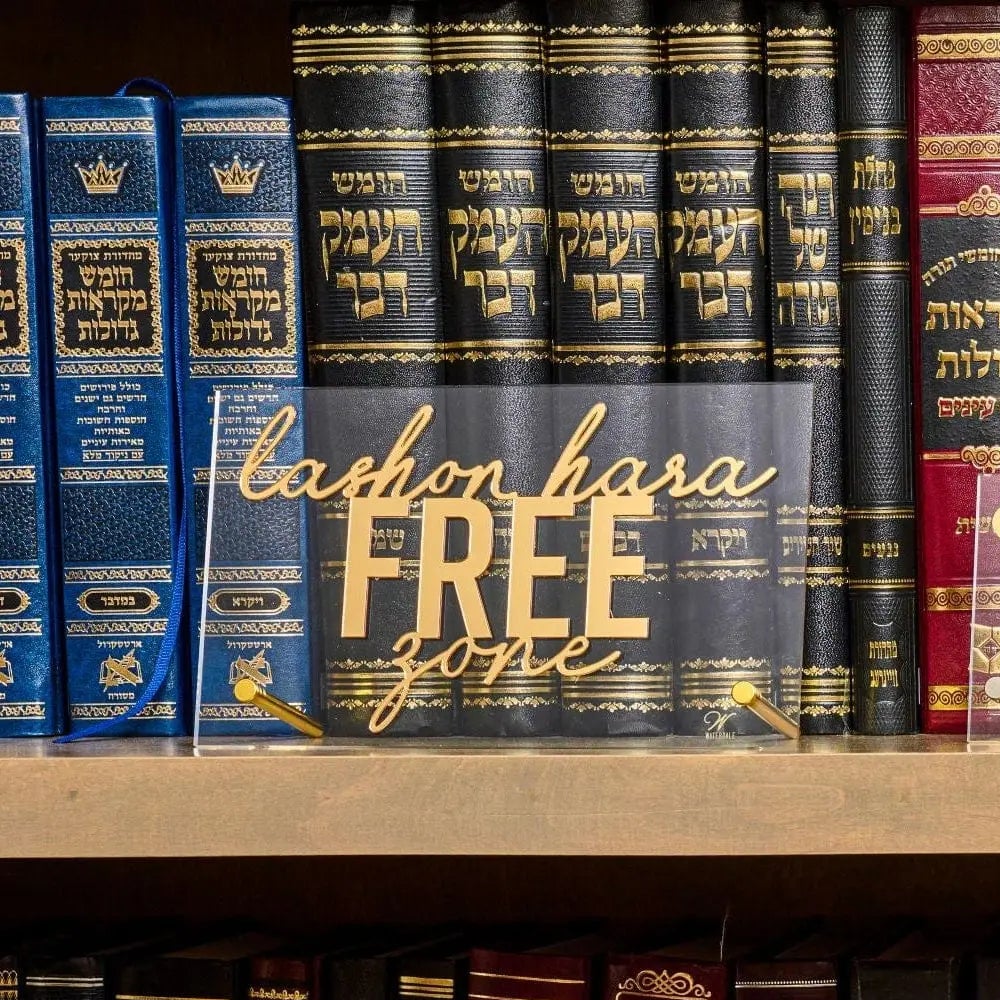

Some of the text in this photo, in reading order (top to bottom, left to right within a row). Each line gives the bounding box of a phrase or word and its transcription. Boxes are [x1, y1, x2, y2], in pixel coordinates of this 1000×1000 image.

[332, 169, 407, 194] חומש
[459, 169, 534, 193] חומש
[570, 171, 645, 196] חומש
[675, 170, 750, 194] חומש
[853, 155, 896, 189] נחלת
[786, 206, 828, 271] של
[849, 205, 901, 245] בנימין
[320, 208, 422, 281] העמק
[449, 205, 549, 280] העמק
[557, 207, 660, 282] העמק
[79, 264, 133, 287] חומש
[212, 265, 267, 287] חומש
[922, 256, 957, 287] תורה
[67, 289, 147, 320] מקראות
[201, 289, 281, 320] מקראות
[336, 271, 408, 320] דבר
[464, 270, 535, 318] דבר
[573, 272, 645, 321] דבר
[680, 271, 752, 320] דבר
[776, 282, 841, 325] תורה
[78, 309, 139, 341] גדולות
[211, 309, 273, 342] גדולות
[938, 397, 994, 419] עינים
[240, 402, 777, 500] lashon hara
[691, 529, 748, 557] ויקרא
[341, 496, 655, 639] FREE
[101, 598, 135, 606] במדבר
[232, 597, 264, 607] ויקרא
[97, 640, 142, 649] ארטסקרול
[227, 640, 272, 649] ארטסקרול
[368, 630, 620, 733] zone
